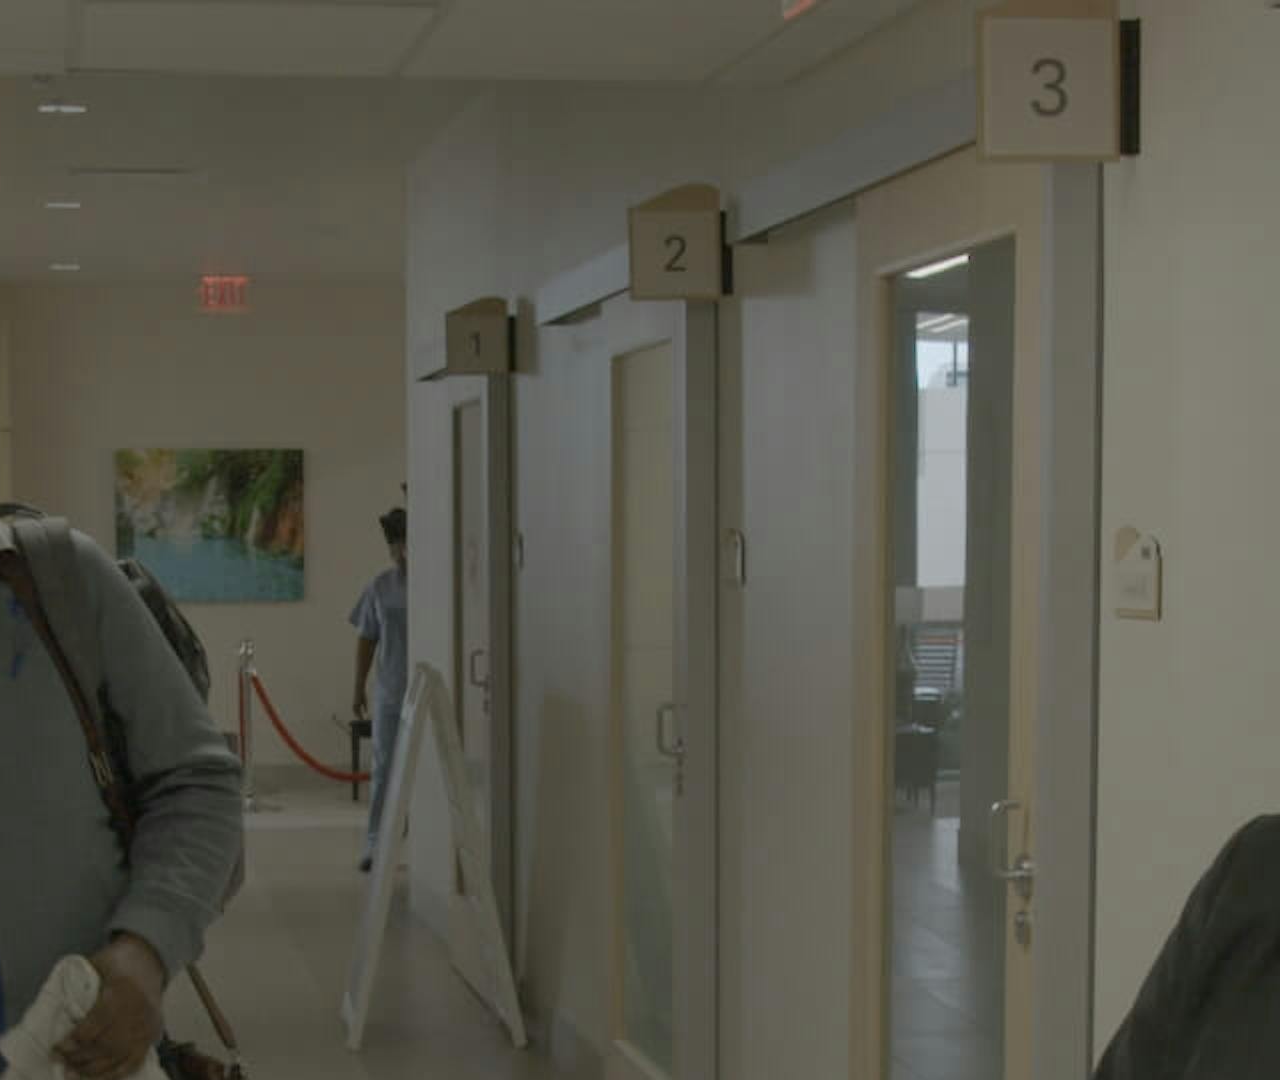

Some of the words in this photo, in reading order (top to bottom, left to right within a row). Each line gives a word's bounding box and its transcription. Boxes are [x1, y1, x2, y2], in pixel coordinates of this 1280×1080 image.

[1030, 57, 1069, 117] 3
[663, 234, 687, 272] 2
[201, 276, 247, 309] EXIT
[469, 332, 481, 358] 1
